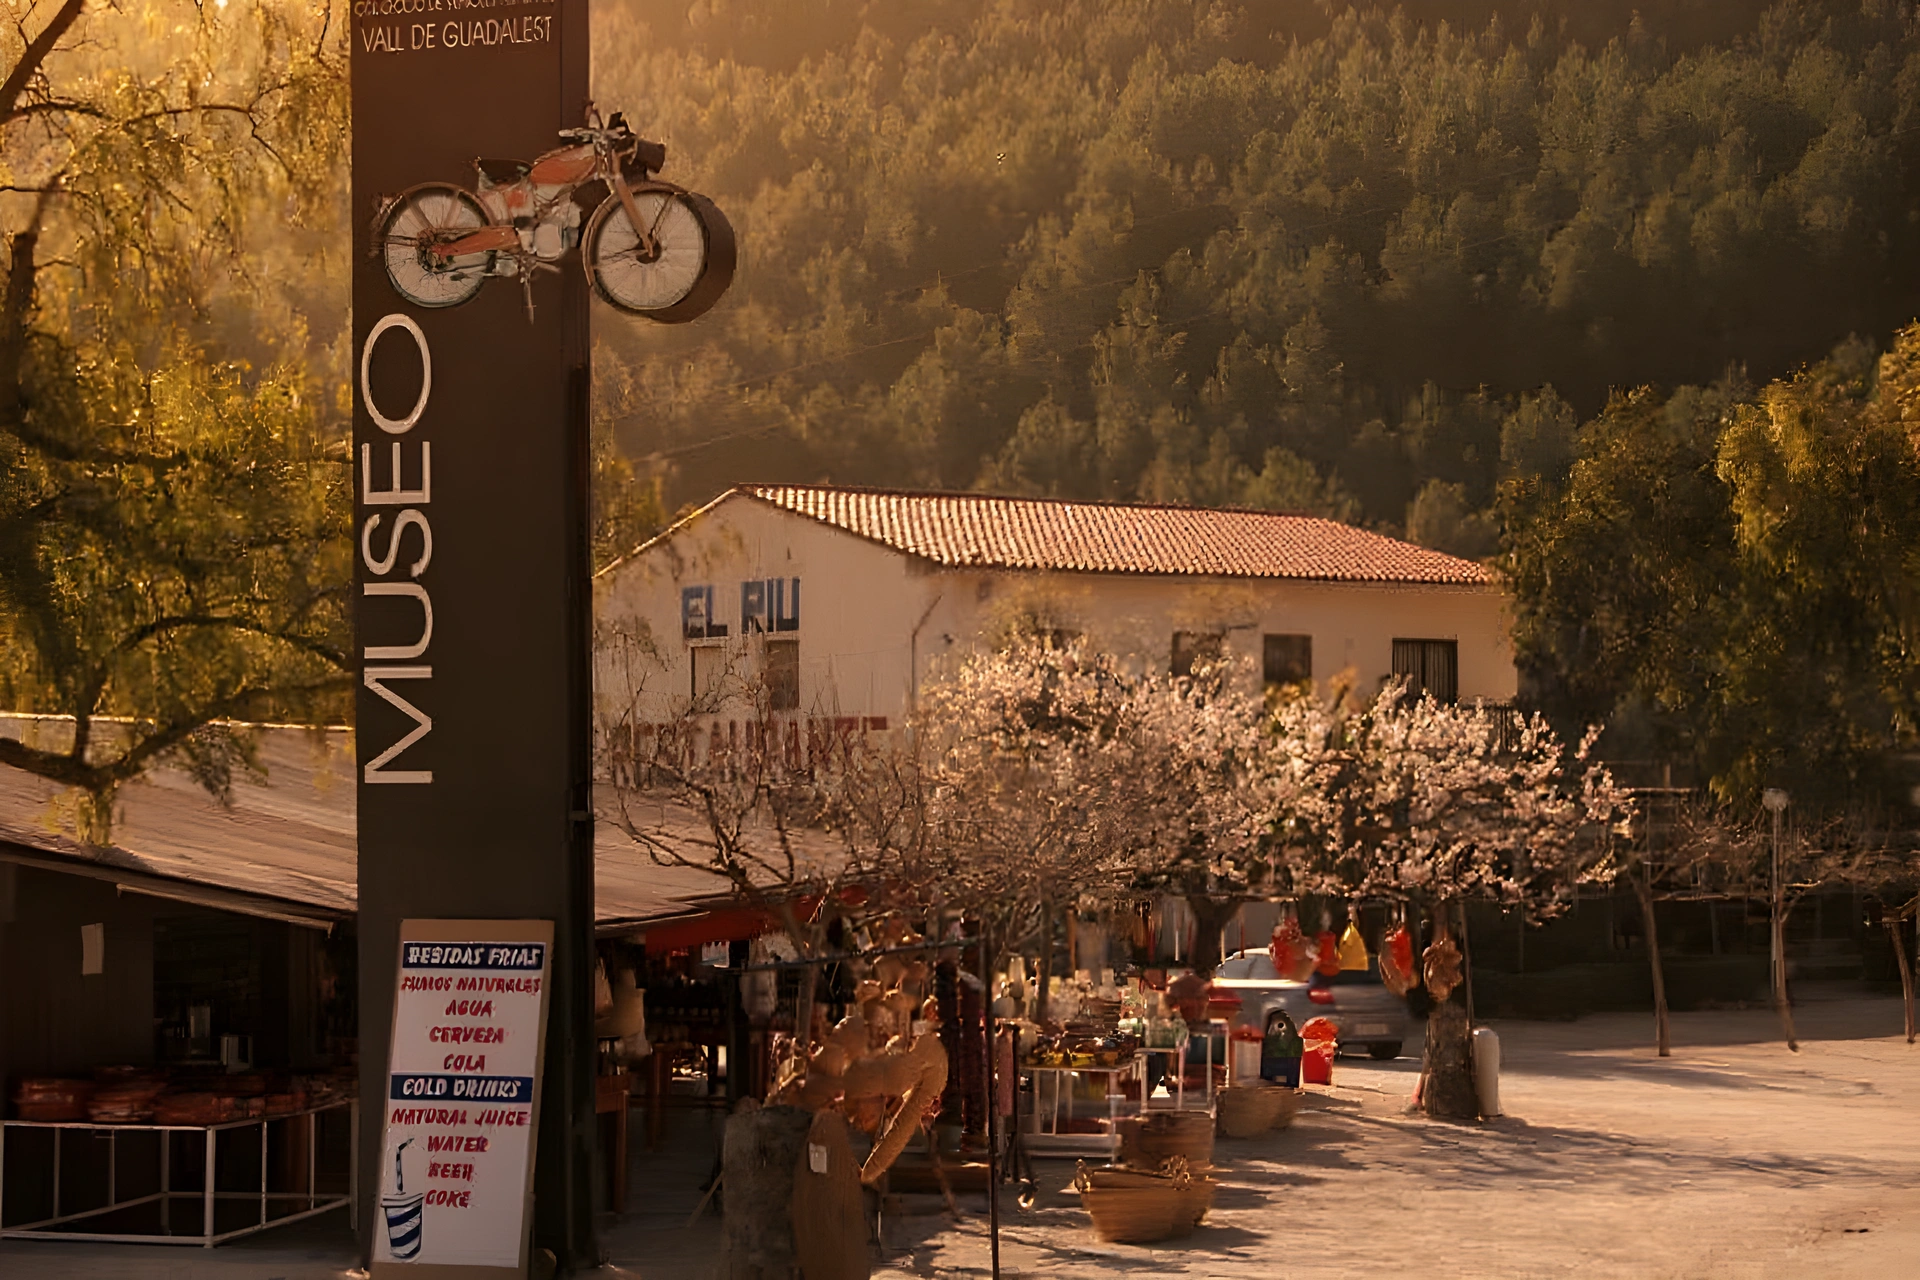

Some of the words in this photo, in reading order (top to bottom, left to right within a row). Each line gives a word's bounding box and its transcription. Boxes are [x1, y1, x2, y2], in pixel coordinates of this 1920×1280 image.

[361, 26, 405, 52] VALL
[411, 23, 436, 50] DE
[442, 16, 552, 48] GUADALEST
[361, 313, 433, 785] MUSEO
[682, 585, 728, 639] EL
[741, 577, 800, 634] RIU
[488, 947, 541, 967] FRIAS
[445, 999, 493, 1018] AGUA
[443, 1053, 486, 1072] COLA
[403, 1077, 448, 1096] COLD
[453, 1079, 522, 1098] DRINKS
[391, 1108, 467, 1127] NATURAL
[474, 1108, 530, 1127] JUICE
[427, 1135, 490, 1153] WATER
[427, 1163, 475, 1181] BEER
[425, 1189, 472, 1208] COKE
